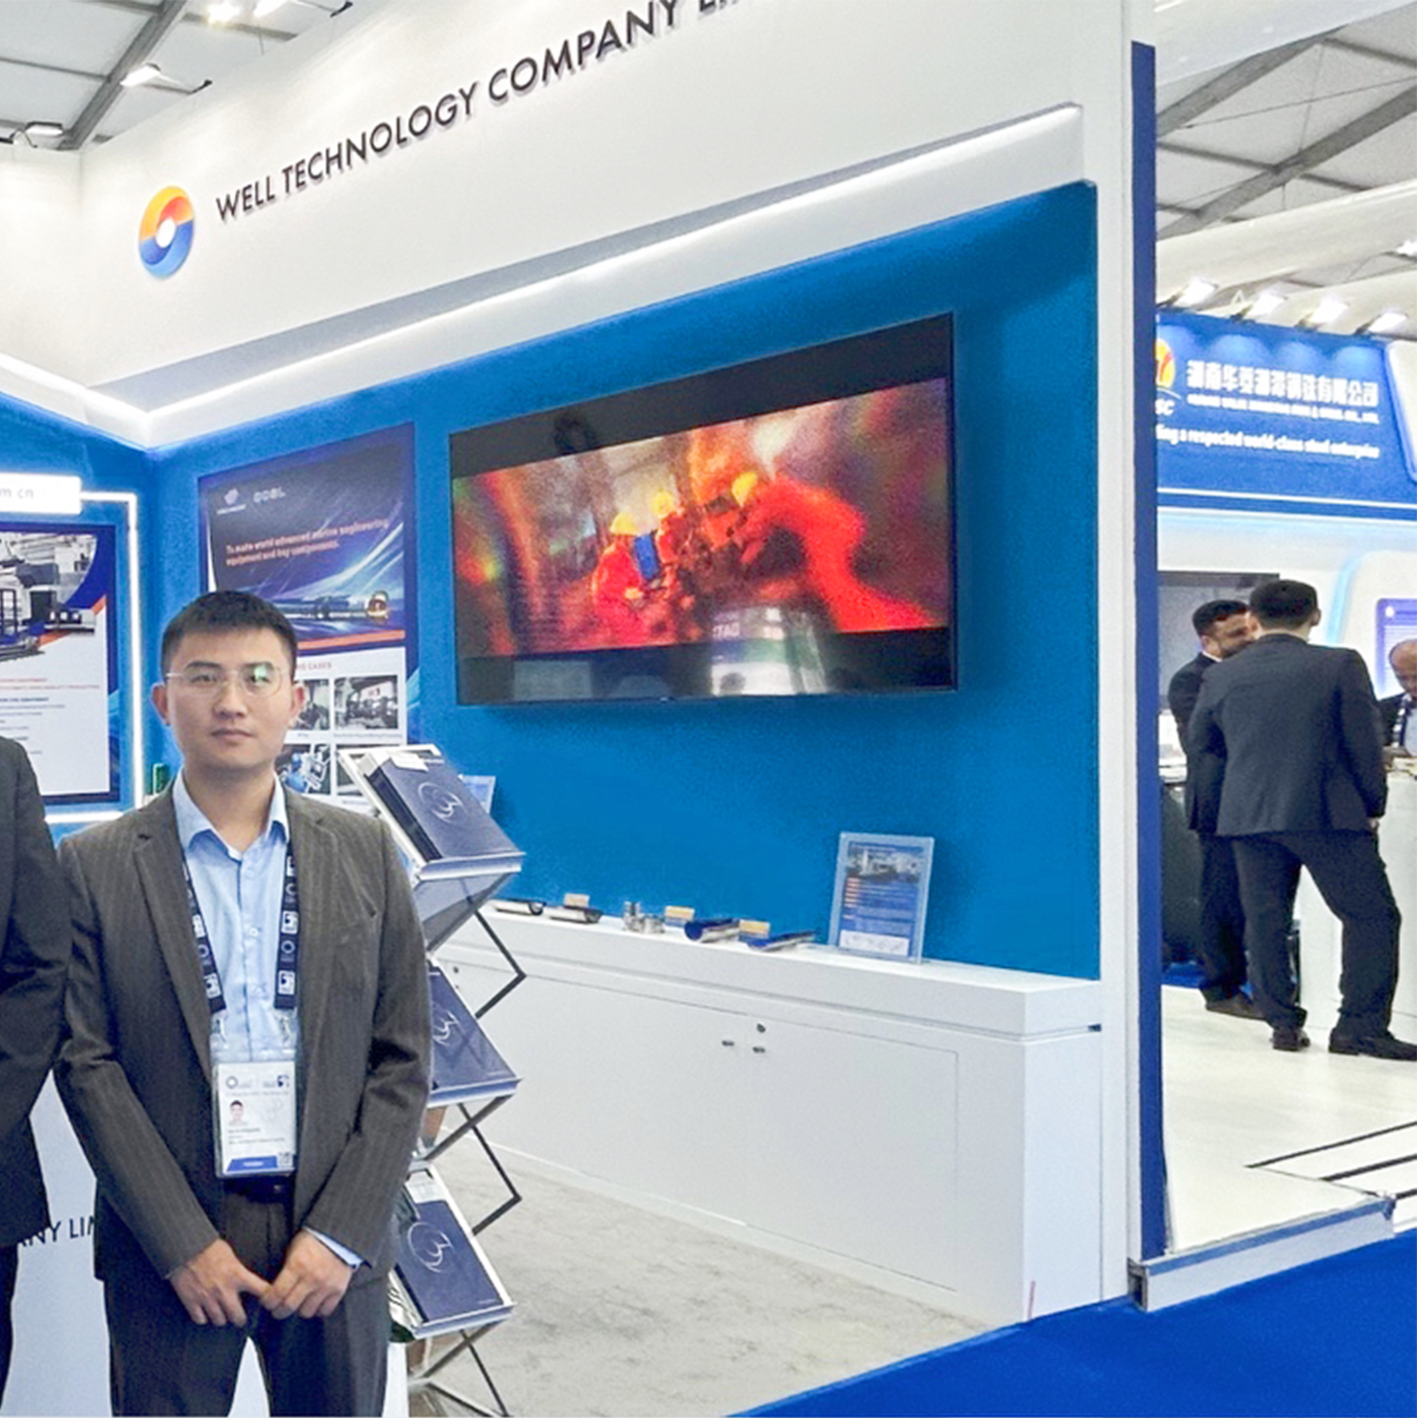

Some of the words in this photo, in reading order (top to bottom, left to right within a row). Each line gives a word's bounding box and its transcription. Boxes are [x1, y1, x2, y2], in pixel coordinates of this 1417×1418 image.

[216, 176, 277, 222] WELL
[281, 81, 479, 195] TECHNOLOGY
[487, 0, 678, 103] COMPANY
